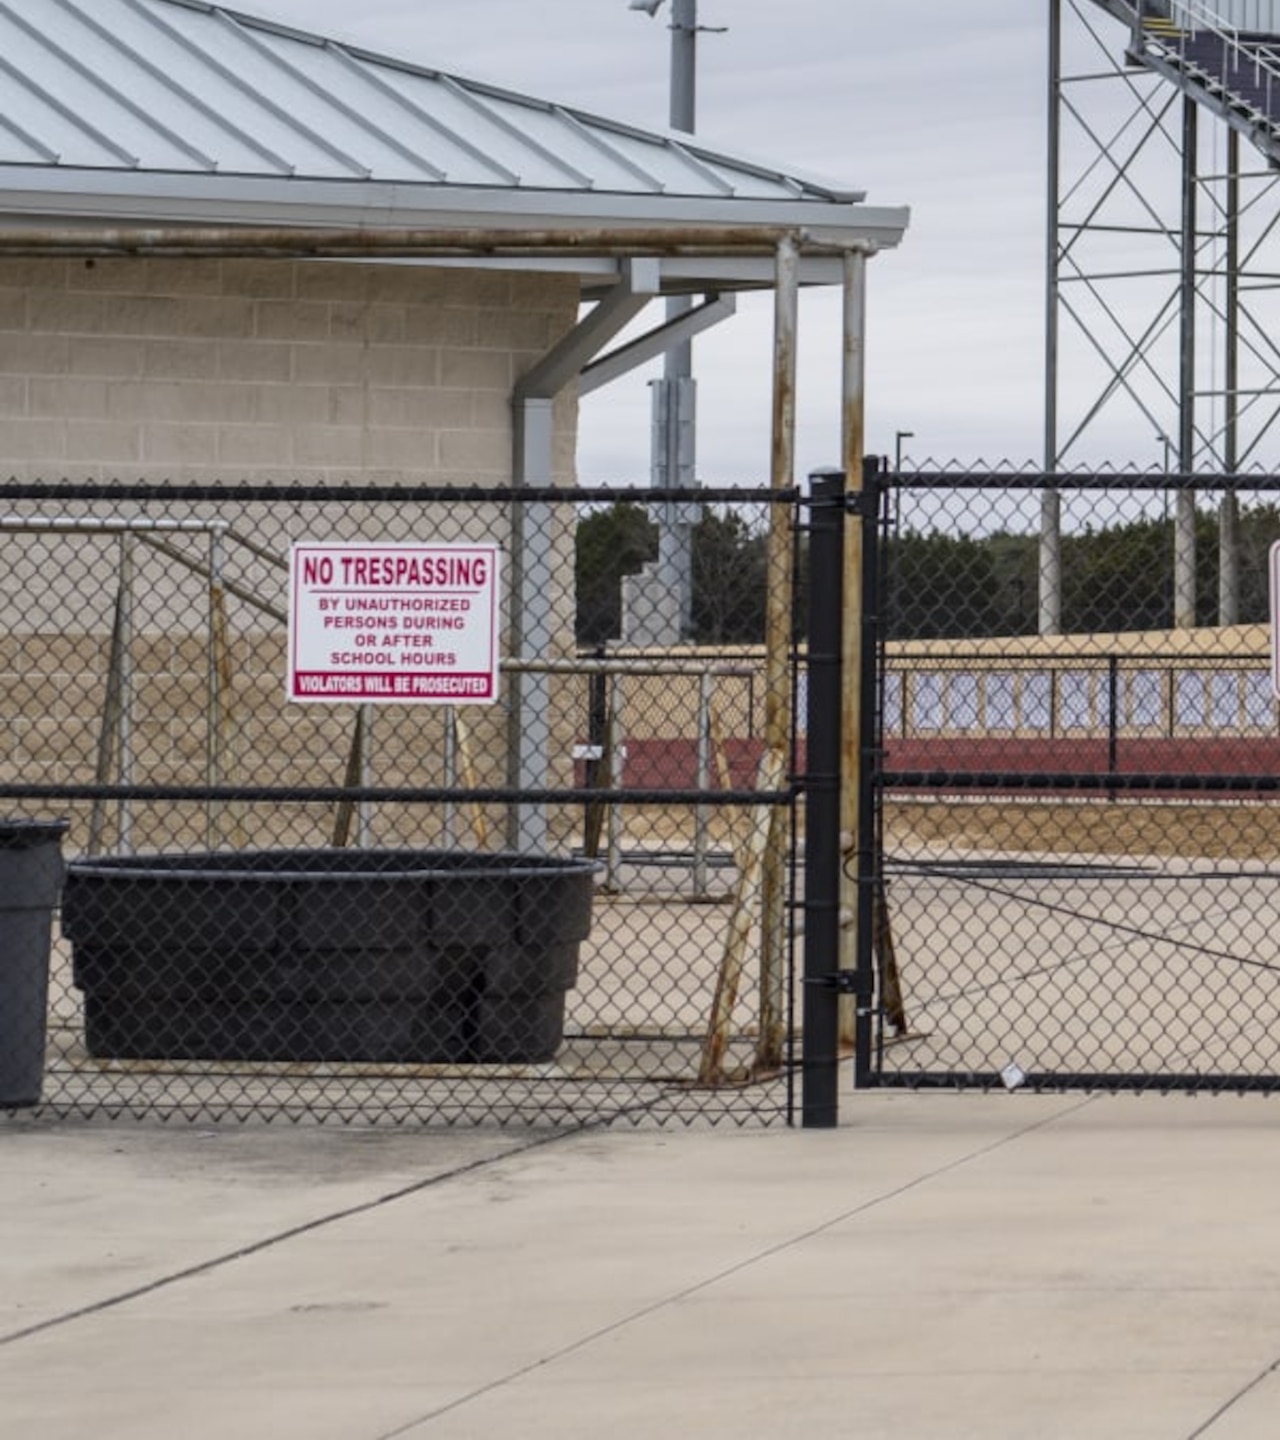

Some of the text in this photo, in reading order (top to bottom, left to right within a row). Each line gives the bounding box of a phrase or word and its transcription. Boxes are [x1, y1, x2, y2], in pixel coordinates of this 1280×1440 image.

[304, 557, 486, 586] NO TRESPASSING
[319, 598, 471, 611] BY UNAUTHORIZED
[324, 616, 465, 630] PERSONS DURING
[355, 634, 432, 647] OR AFTER
[330, 652, 456, 666] SCHOOL HOURS
[300, 675, 487, 693] VIOLATORS WILL BE PROSECUTED
